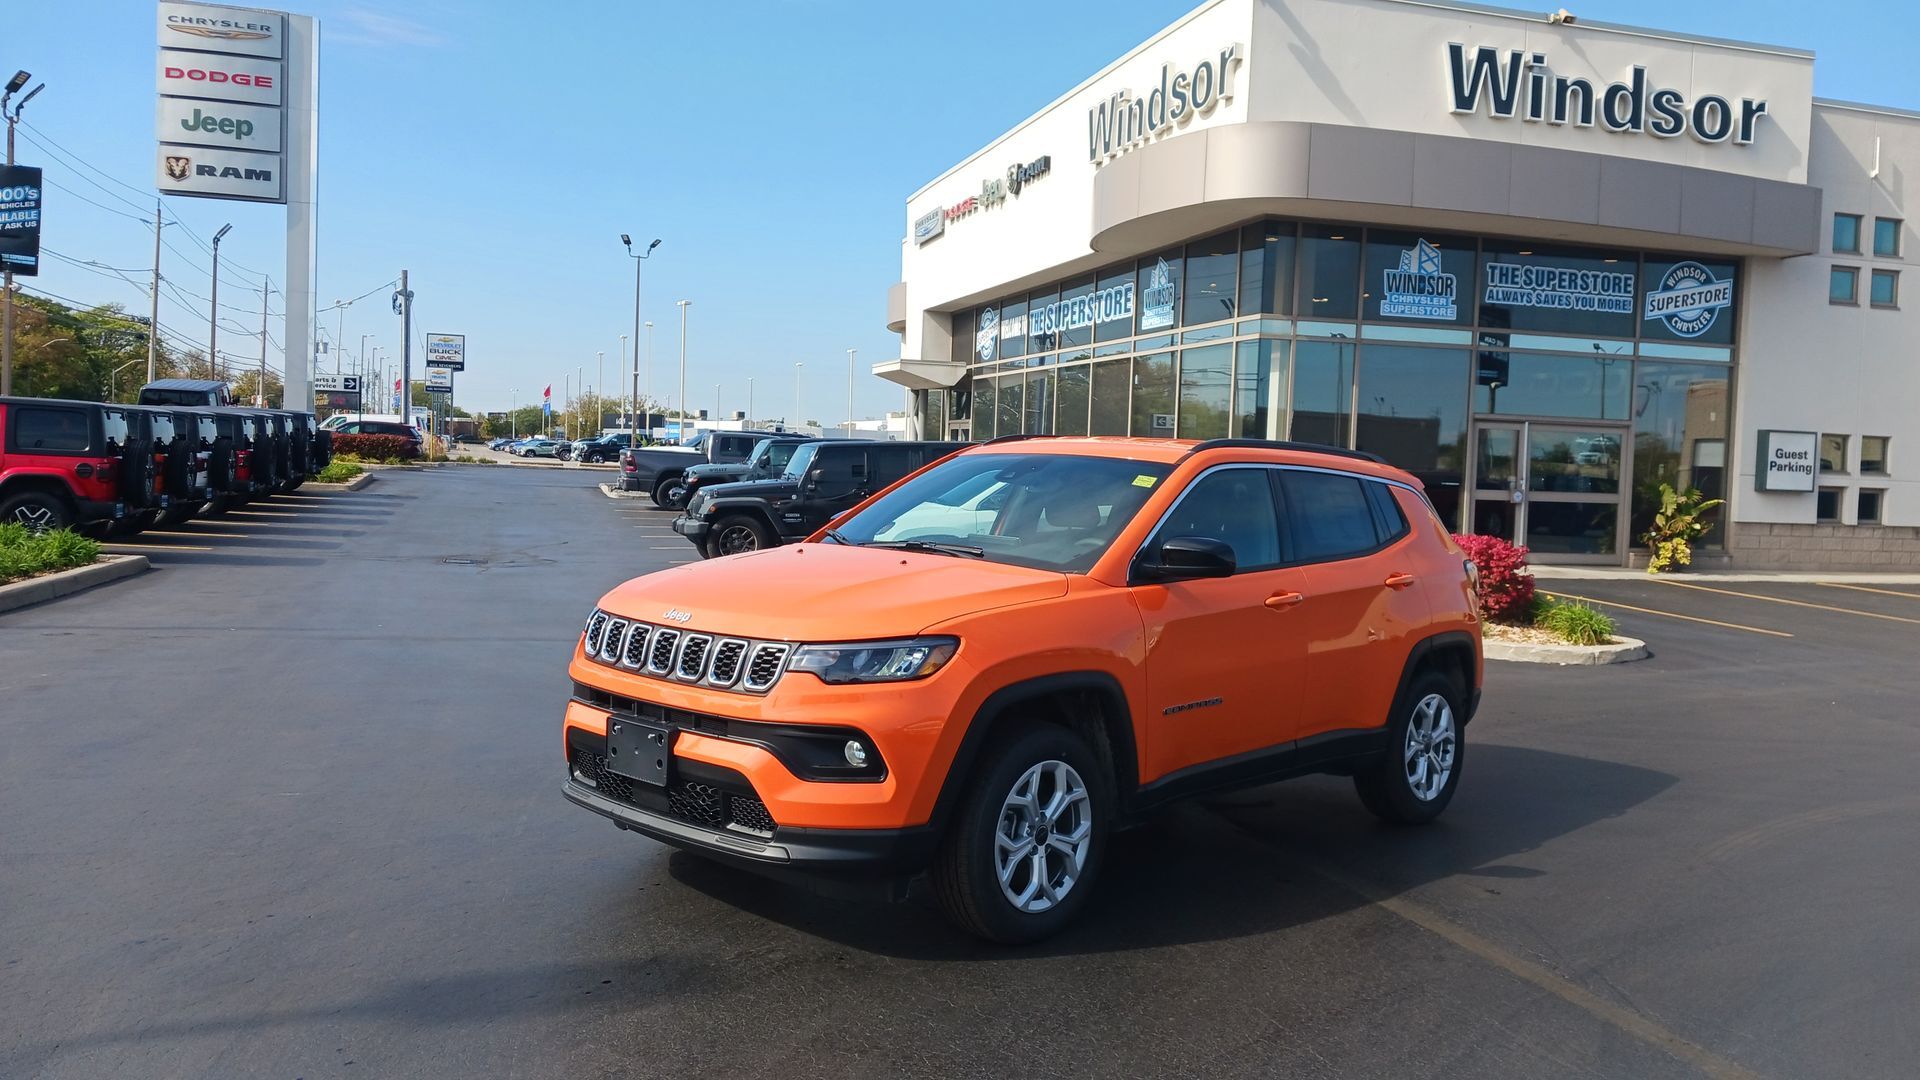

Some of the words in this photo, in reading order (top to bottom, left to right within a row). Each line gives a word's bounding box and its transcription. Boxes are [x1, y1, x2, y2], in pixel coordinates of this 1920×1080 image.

[167, 15, 272, 32] CHRYSLER
[165, 67, 272, 88] DODGE
[1088, 43, 1241, 165] Windsor
[1447, 41, 1768, 145] Windsor
[181, 108, 254, 140] Jeep
[196, 164, 272, 181] RAM
[1019, 156, 1051, 182] RAM
[4, 222, 23, 230] ASK
[1386, 272, 1454, 297] WINDSOR
[1488, 265, 1521, 286] THE
[1523, 267, 1633, 295] SUPERSTORE
[1667, 267, 1707, 287] WINDSOR
[1046, 284, 1134, 334] SUPERSTORE
[1383, 304, 1454, 317] SUPERSTORE
[1391, 295, 1447, 305] CHRYSLER
[1486, 288, 1533, 305] ALWAYS
[1535, 291, 1572, 307] SAVES
[1573, 294, 1598, 309] YOU
[1599, 297, 1633, 312] MORE!
[1649, 287, 1729, 313] SUPERSTORE
[1030, 309, 1045, 336] THE
[1671, 310, 1711, 332] CHRYSLER
[1775, 448, 1809, 460] Guest
[1769, 460, 1813, 476] Parking
[664, 608, 692, 624] Jeep
